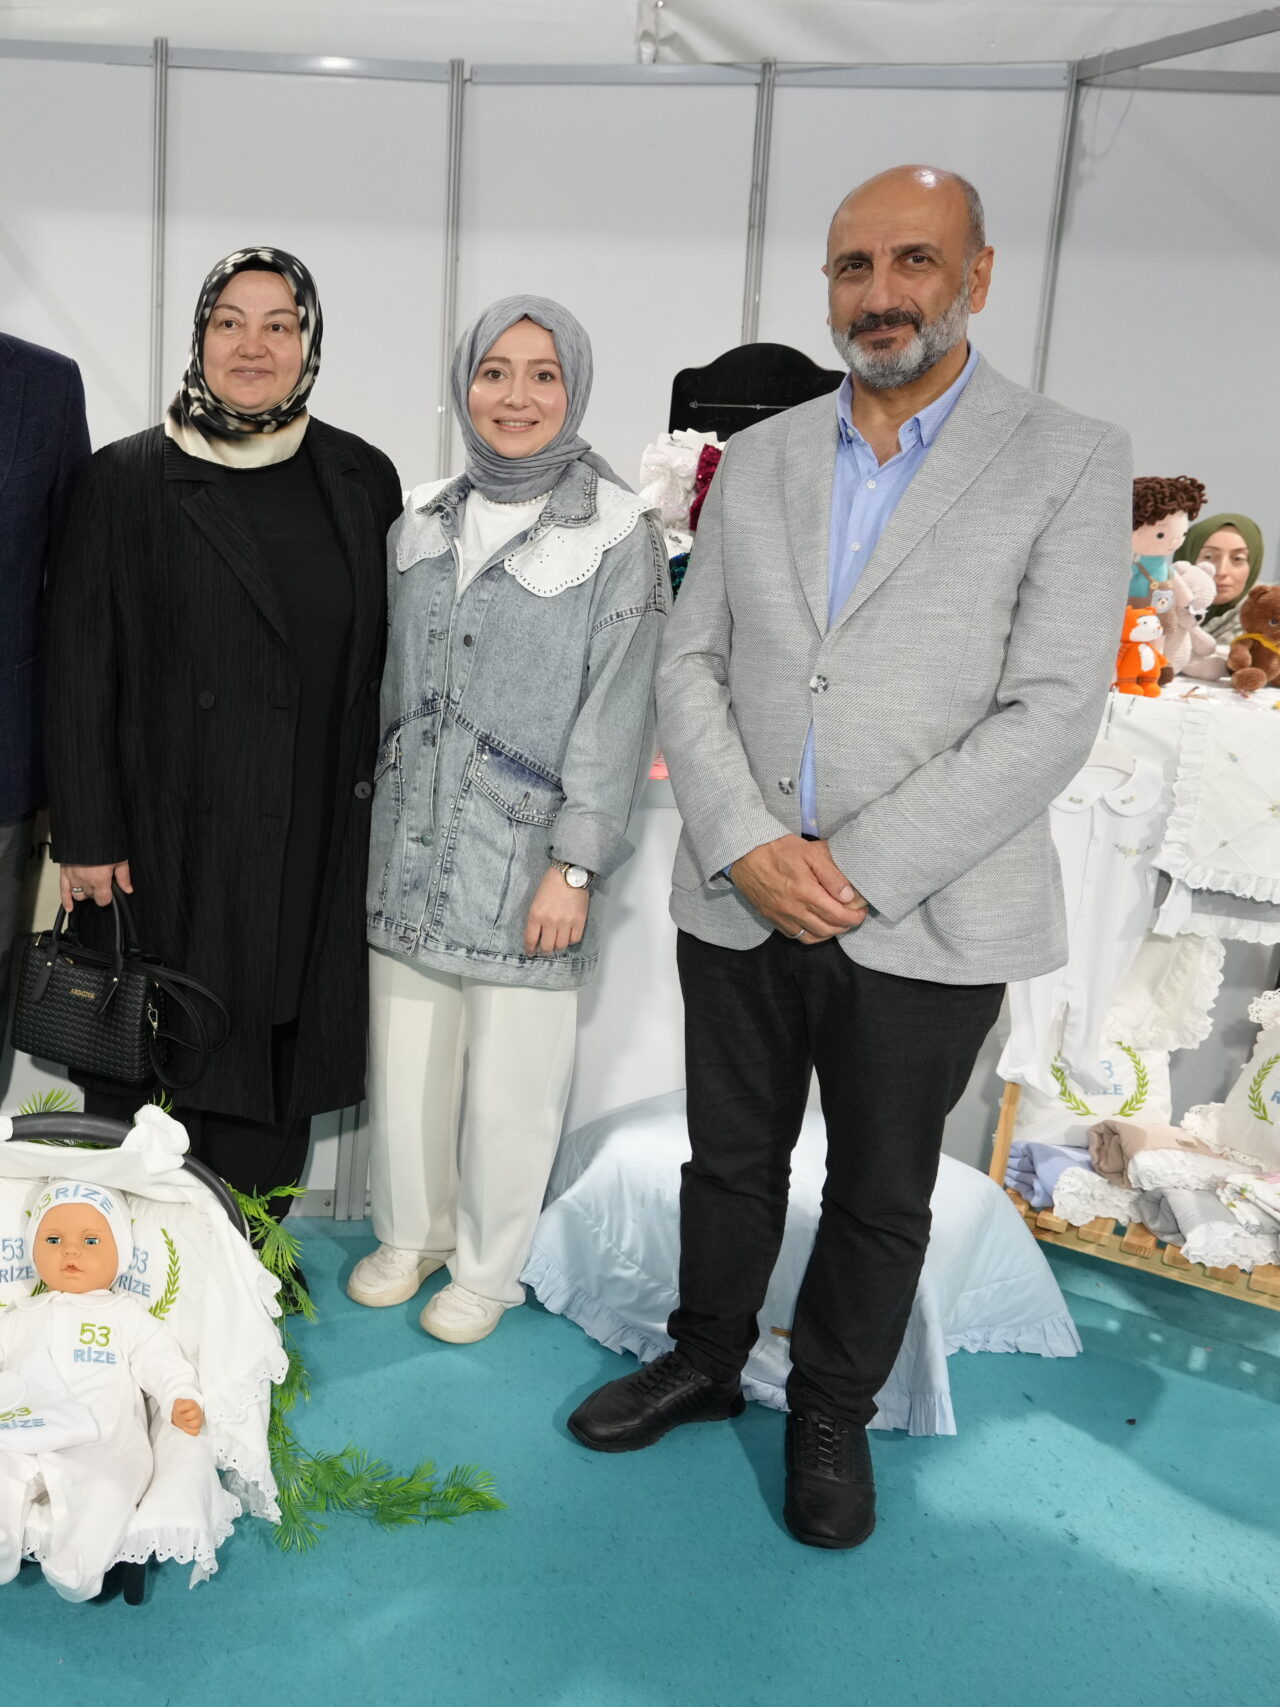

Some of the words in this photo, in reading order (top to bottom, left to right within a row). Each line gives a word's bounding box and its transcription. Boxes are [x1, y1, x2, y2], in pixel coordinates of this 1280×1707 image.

[1, 1238, 24, 1261] 53
[128, 1245, 149, 1274] 53
[79, 1322, 111, 1347] 53
